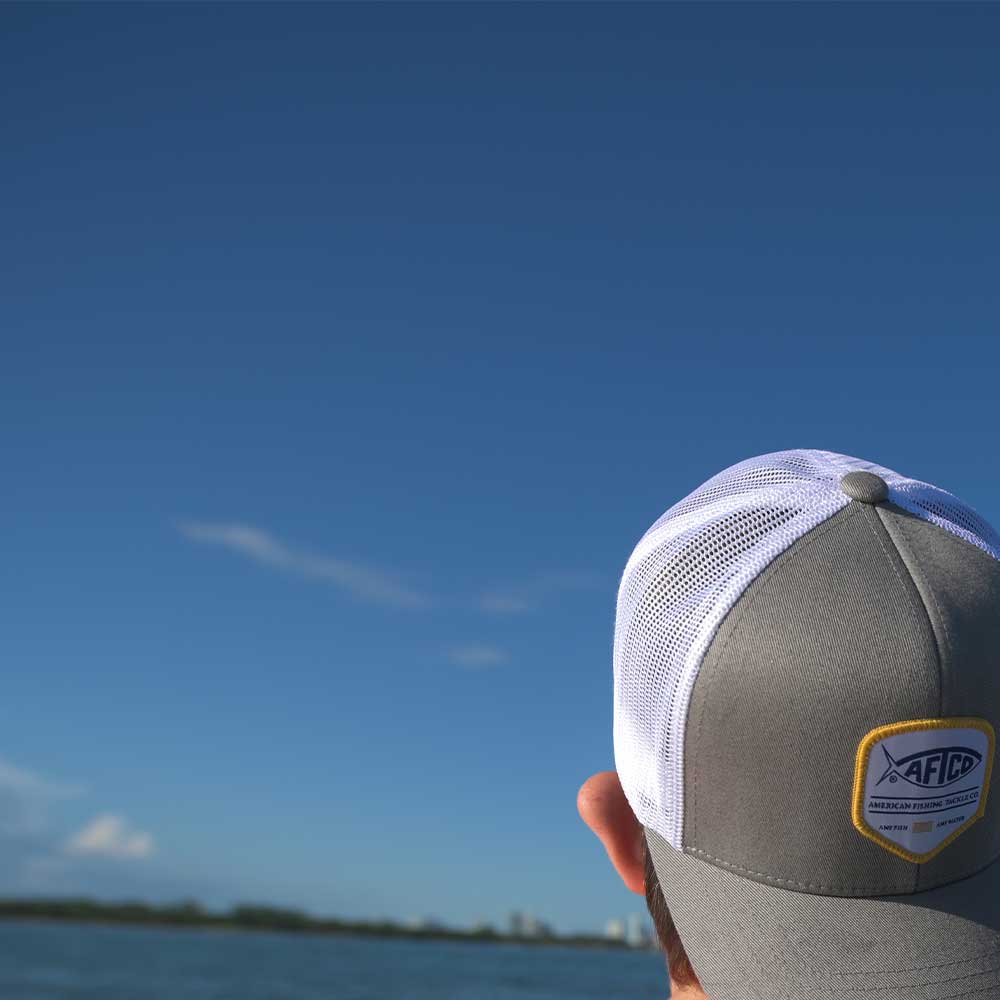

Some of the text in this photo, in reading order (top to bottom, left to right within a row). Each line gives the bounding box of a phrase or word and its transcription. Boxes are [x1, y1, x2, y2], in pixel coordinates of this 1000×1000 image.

[903, 747, 975, 785] AFTCO
[868, 801, 911, 810] AMERICAN
[912, 800, 943, 810] FISHING
